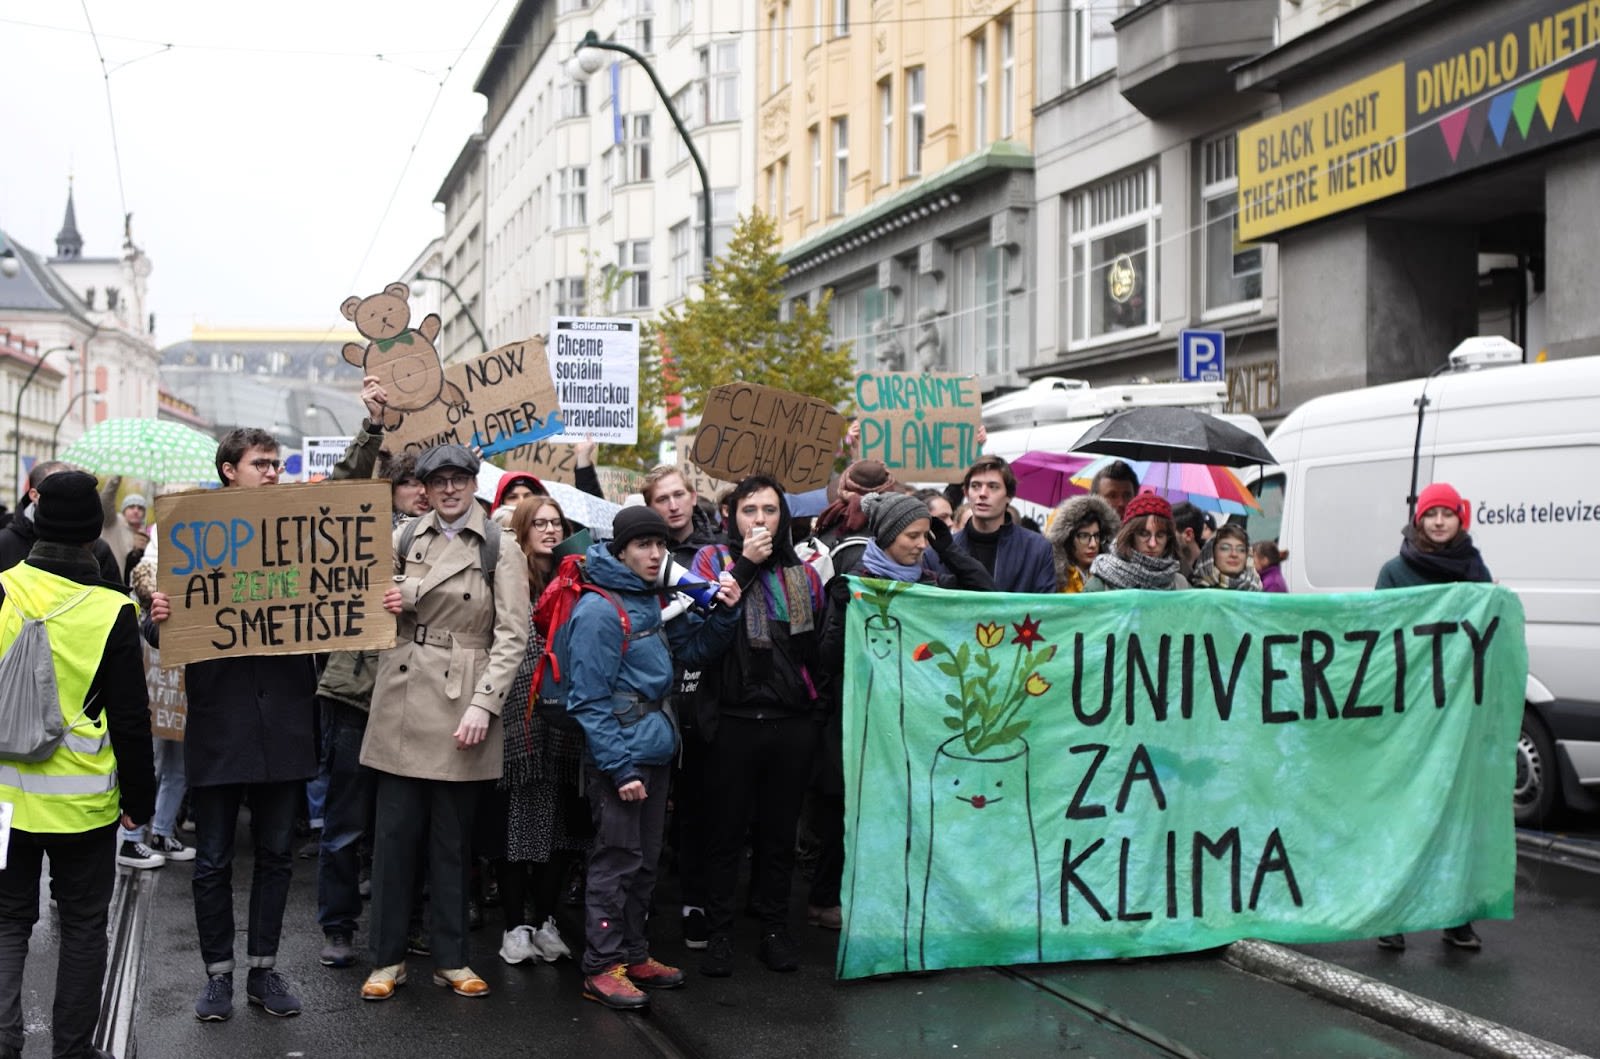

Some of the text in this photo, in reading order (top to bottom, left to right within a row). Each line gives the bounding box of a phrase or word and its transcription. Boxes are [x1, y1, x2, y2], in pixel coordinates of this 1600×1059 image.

[1417, 33, 1518, 115] DIVADLO
[1257, 92, 1380, 173] BLACK LIGHT
[1243, 136, 1397, 224] THEATRE METRO
[557, 334, 604, 357] Chceme
[571, 321, 620, 331] Solidarita
[465, 346, 525, 393] NOW
[556, 358, 604, 380] sociální
[1190, 337, 1216, 377] P
[447, 401, 475, 425] OR
[562, 381, 630, 405] klimatickou
[714, 386, 837, 445] #CLIMATE
[856, 372, 975, 412] CHRAŇME
[473, 402, 544, 448] LATER
[1477, 500, 1600, 525] Česká televize
[170, 503, 377, 576] STOP LETIŠTĚ
[186, 560, 378, 609] AŤ ZEMĚ NENÍ
[211, 594, 366, 650] SMETIŠTĚ
[1073, 615, 1500, 726] UNIVERZITY
[1065, 743, 1167, 820] ZA
[1060, 827, 1304, 927] KLIMA
